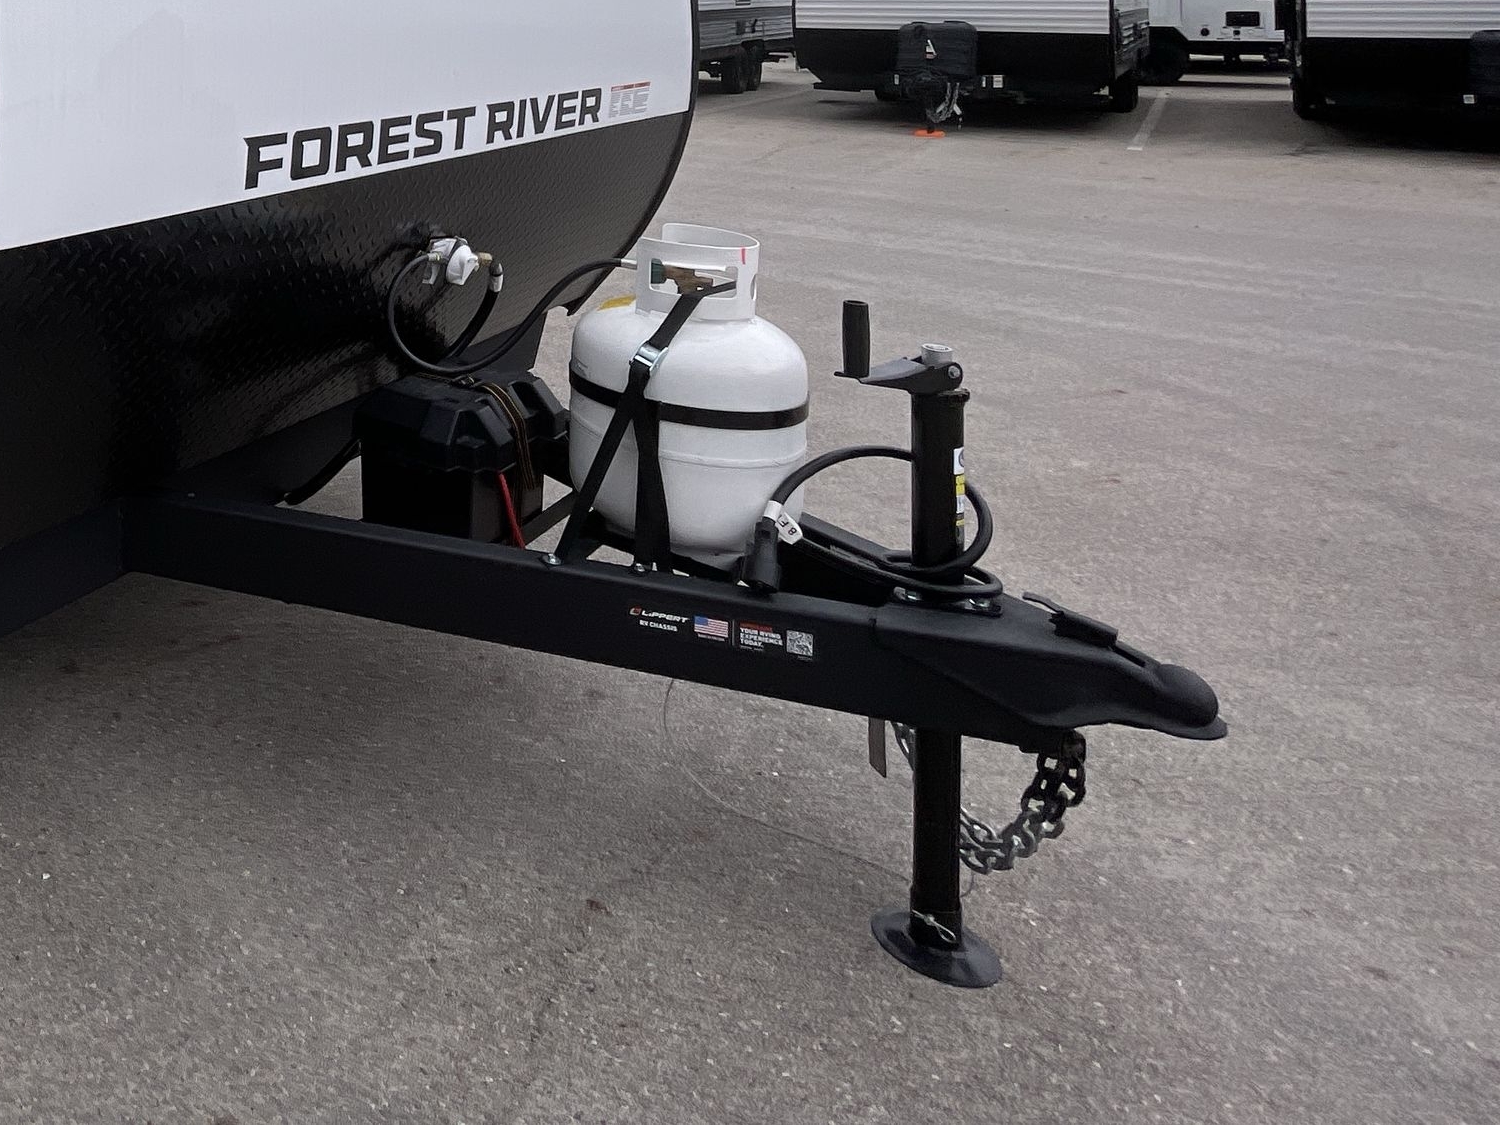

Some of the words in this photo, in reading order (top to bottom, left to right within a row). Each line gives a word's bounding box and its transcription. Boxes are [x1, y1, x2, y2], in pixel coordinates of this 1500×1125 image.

[243, 106, 477, 190] FOREST
[486, 87, 602, 144] RIVER
[641, 610, 690, 623] LIPPERT
